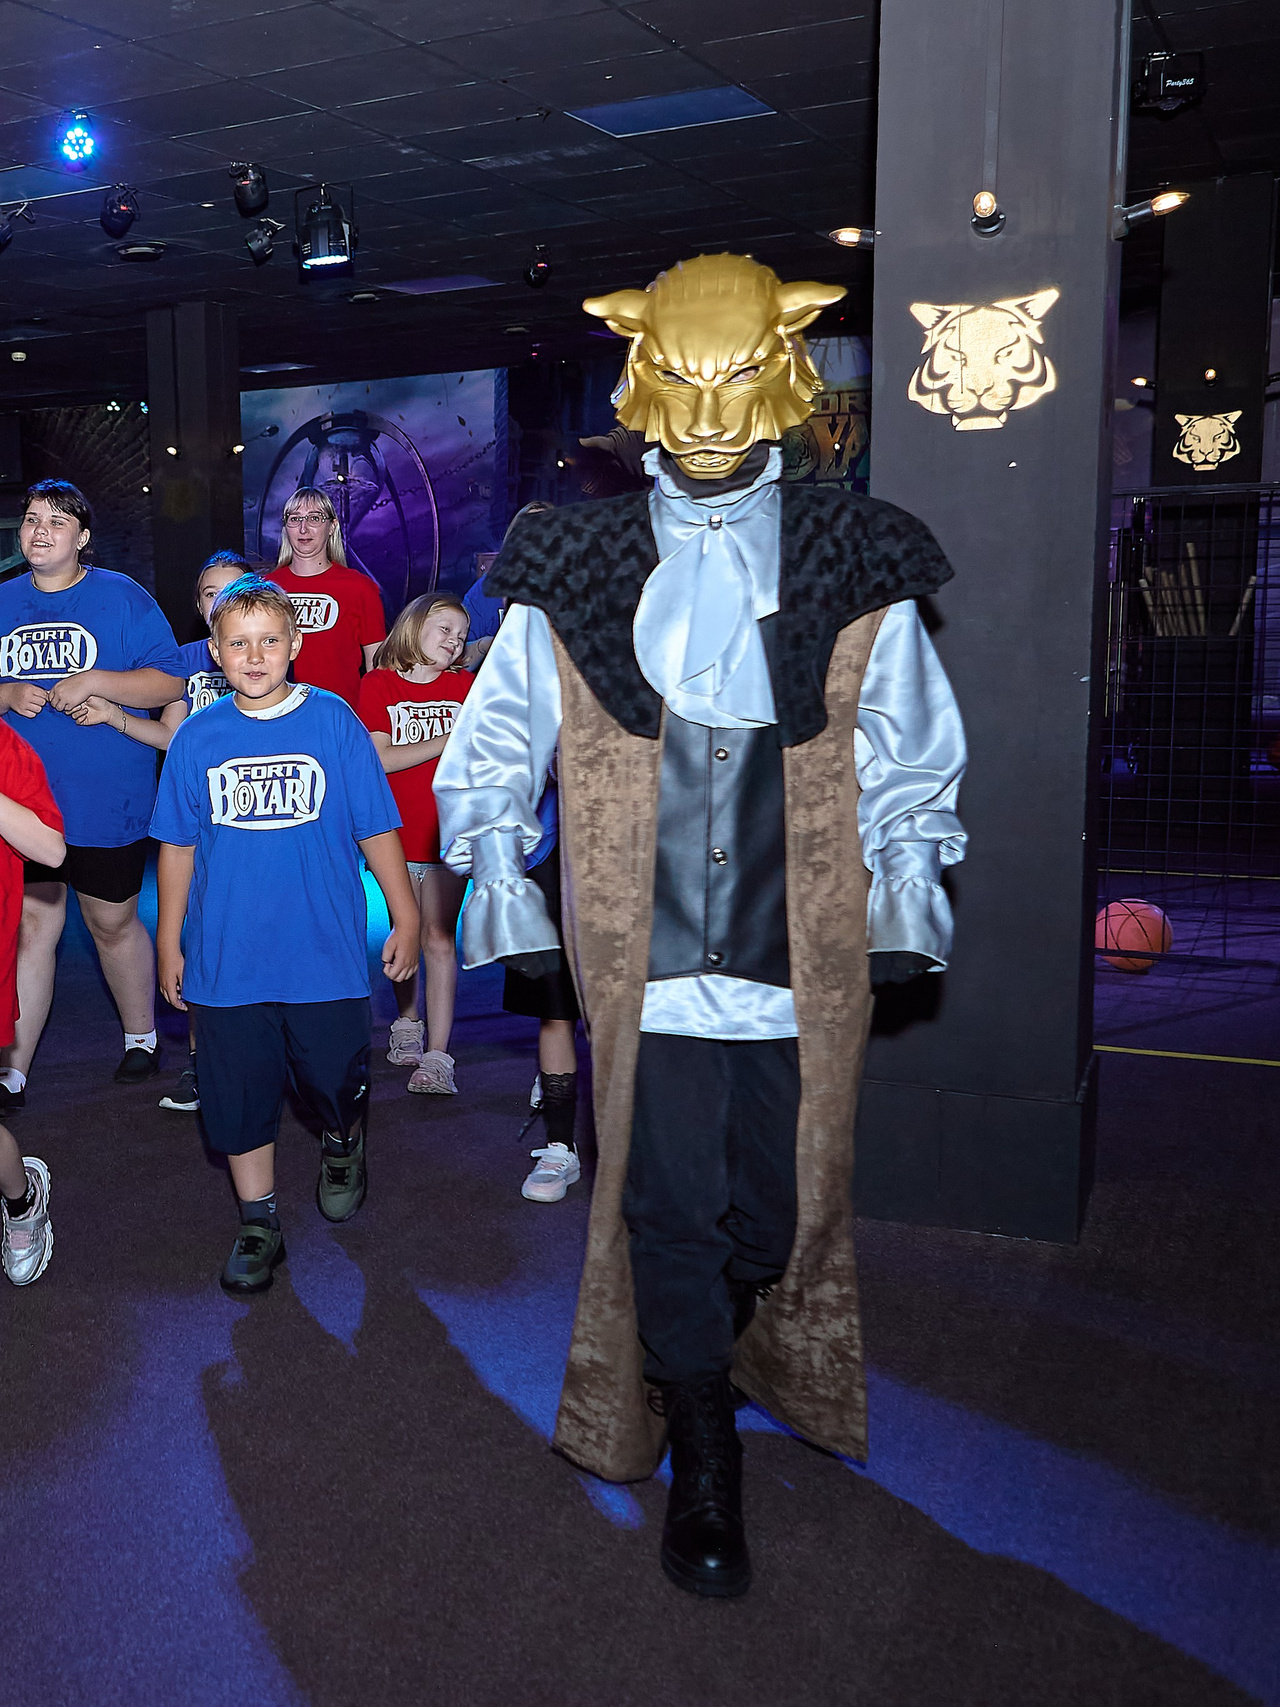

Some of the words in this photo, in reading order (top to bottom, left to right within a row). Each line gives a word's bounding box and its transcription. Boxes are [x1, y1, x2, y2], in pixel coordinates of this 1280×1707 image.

[290, 598, 319, 606] ORT
[22, 629, 68, 642] FORT
[0, 628, 98, 678] BOYARD
[409, 707, 450, 718] FORT
[239, 763, 298, 780] FORT
[207, 763, 326, 826] BOYARD
